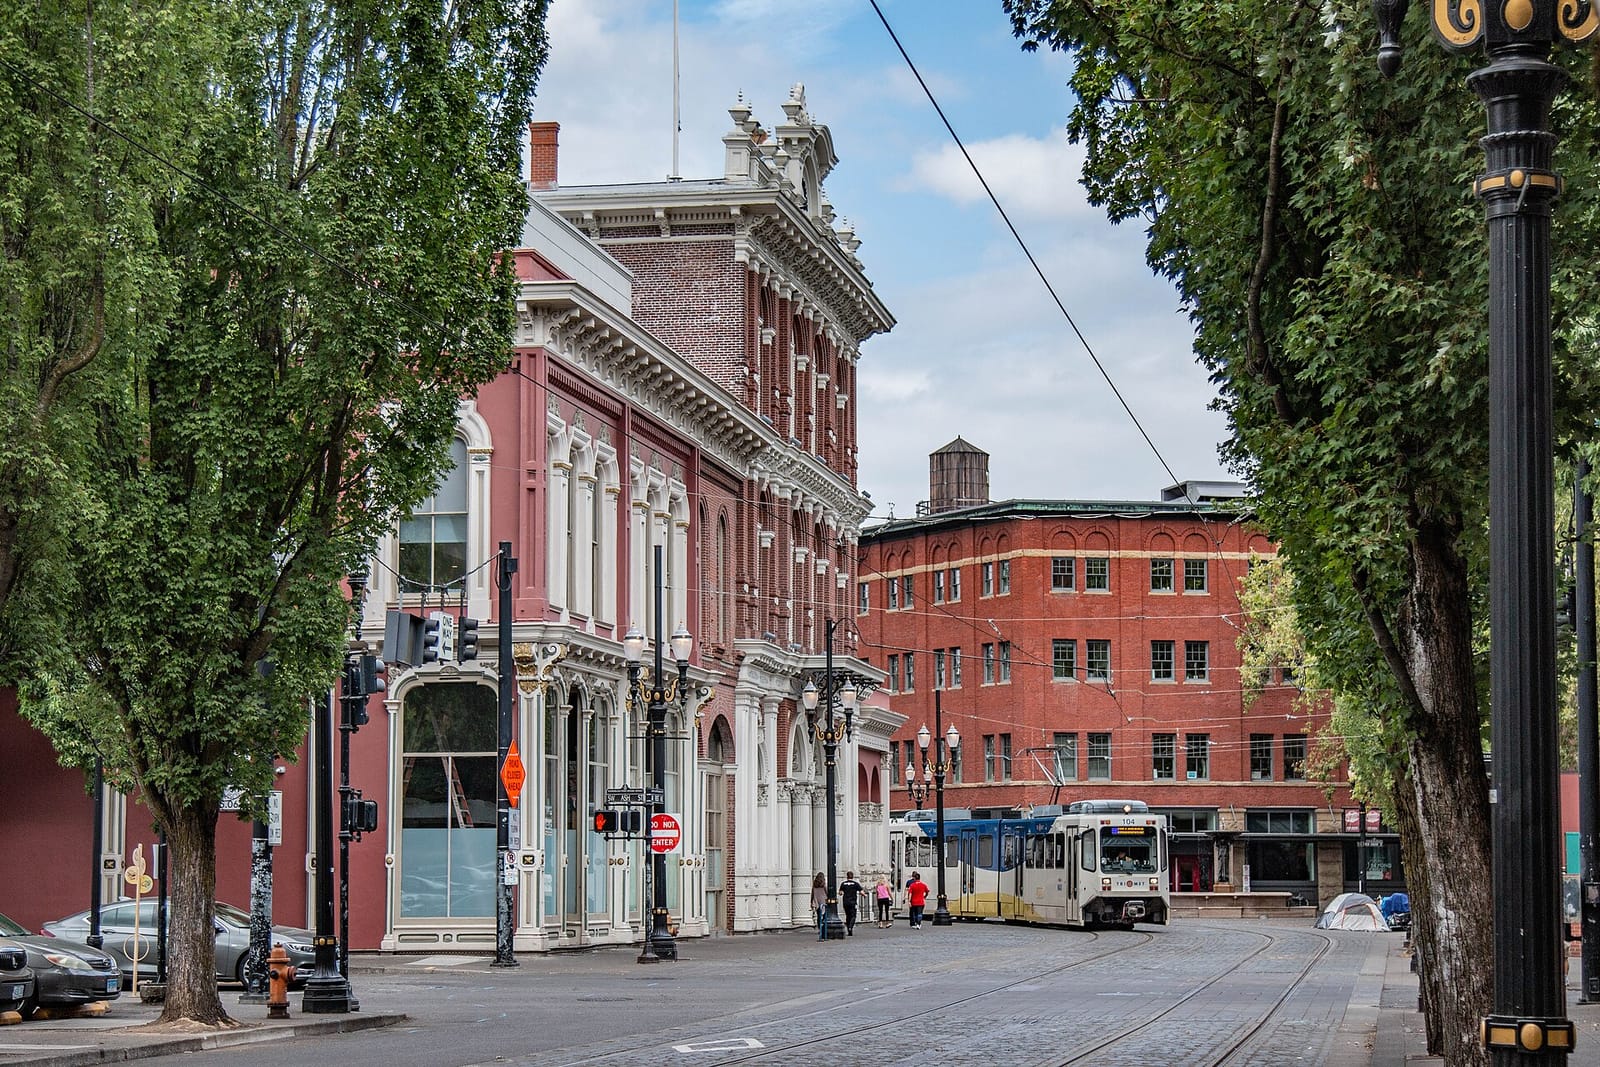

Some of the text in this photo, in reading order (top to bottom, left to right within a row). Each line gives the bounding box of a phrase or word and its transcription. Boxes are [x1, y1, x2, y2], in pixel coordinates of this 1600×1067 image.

[443, 616, 452, 627] ONE
[443, 630, 452, 639] WAY
[508, 759, 519, 768] ROAD
[506, 770, 521, 780] CLOSED
[508, 782, 521, 791] AHEAD
[651, 821, 676, 829] DO NOT
[651, 838, 674, 846] ENTER
